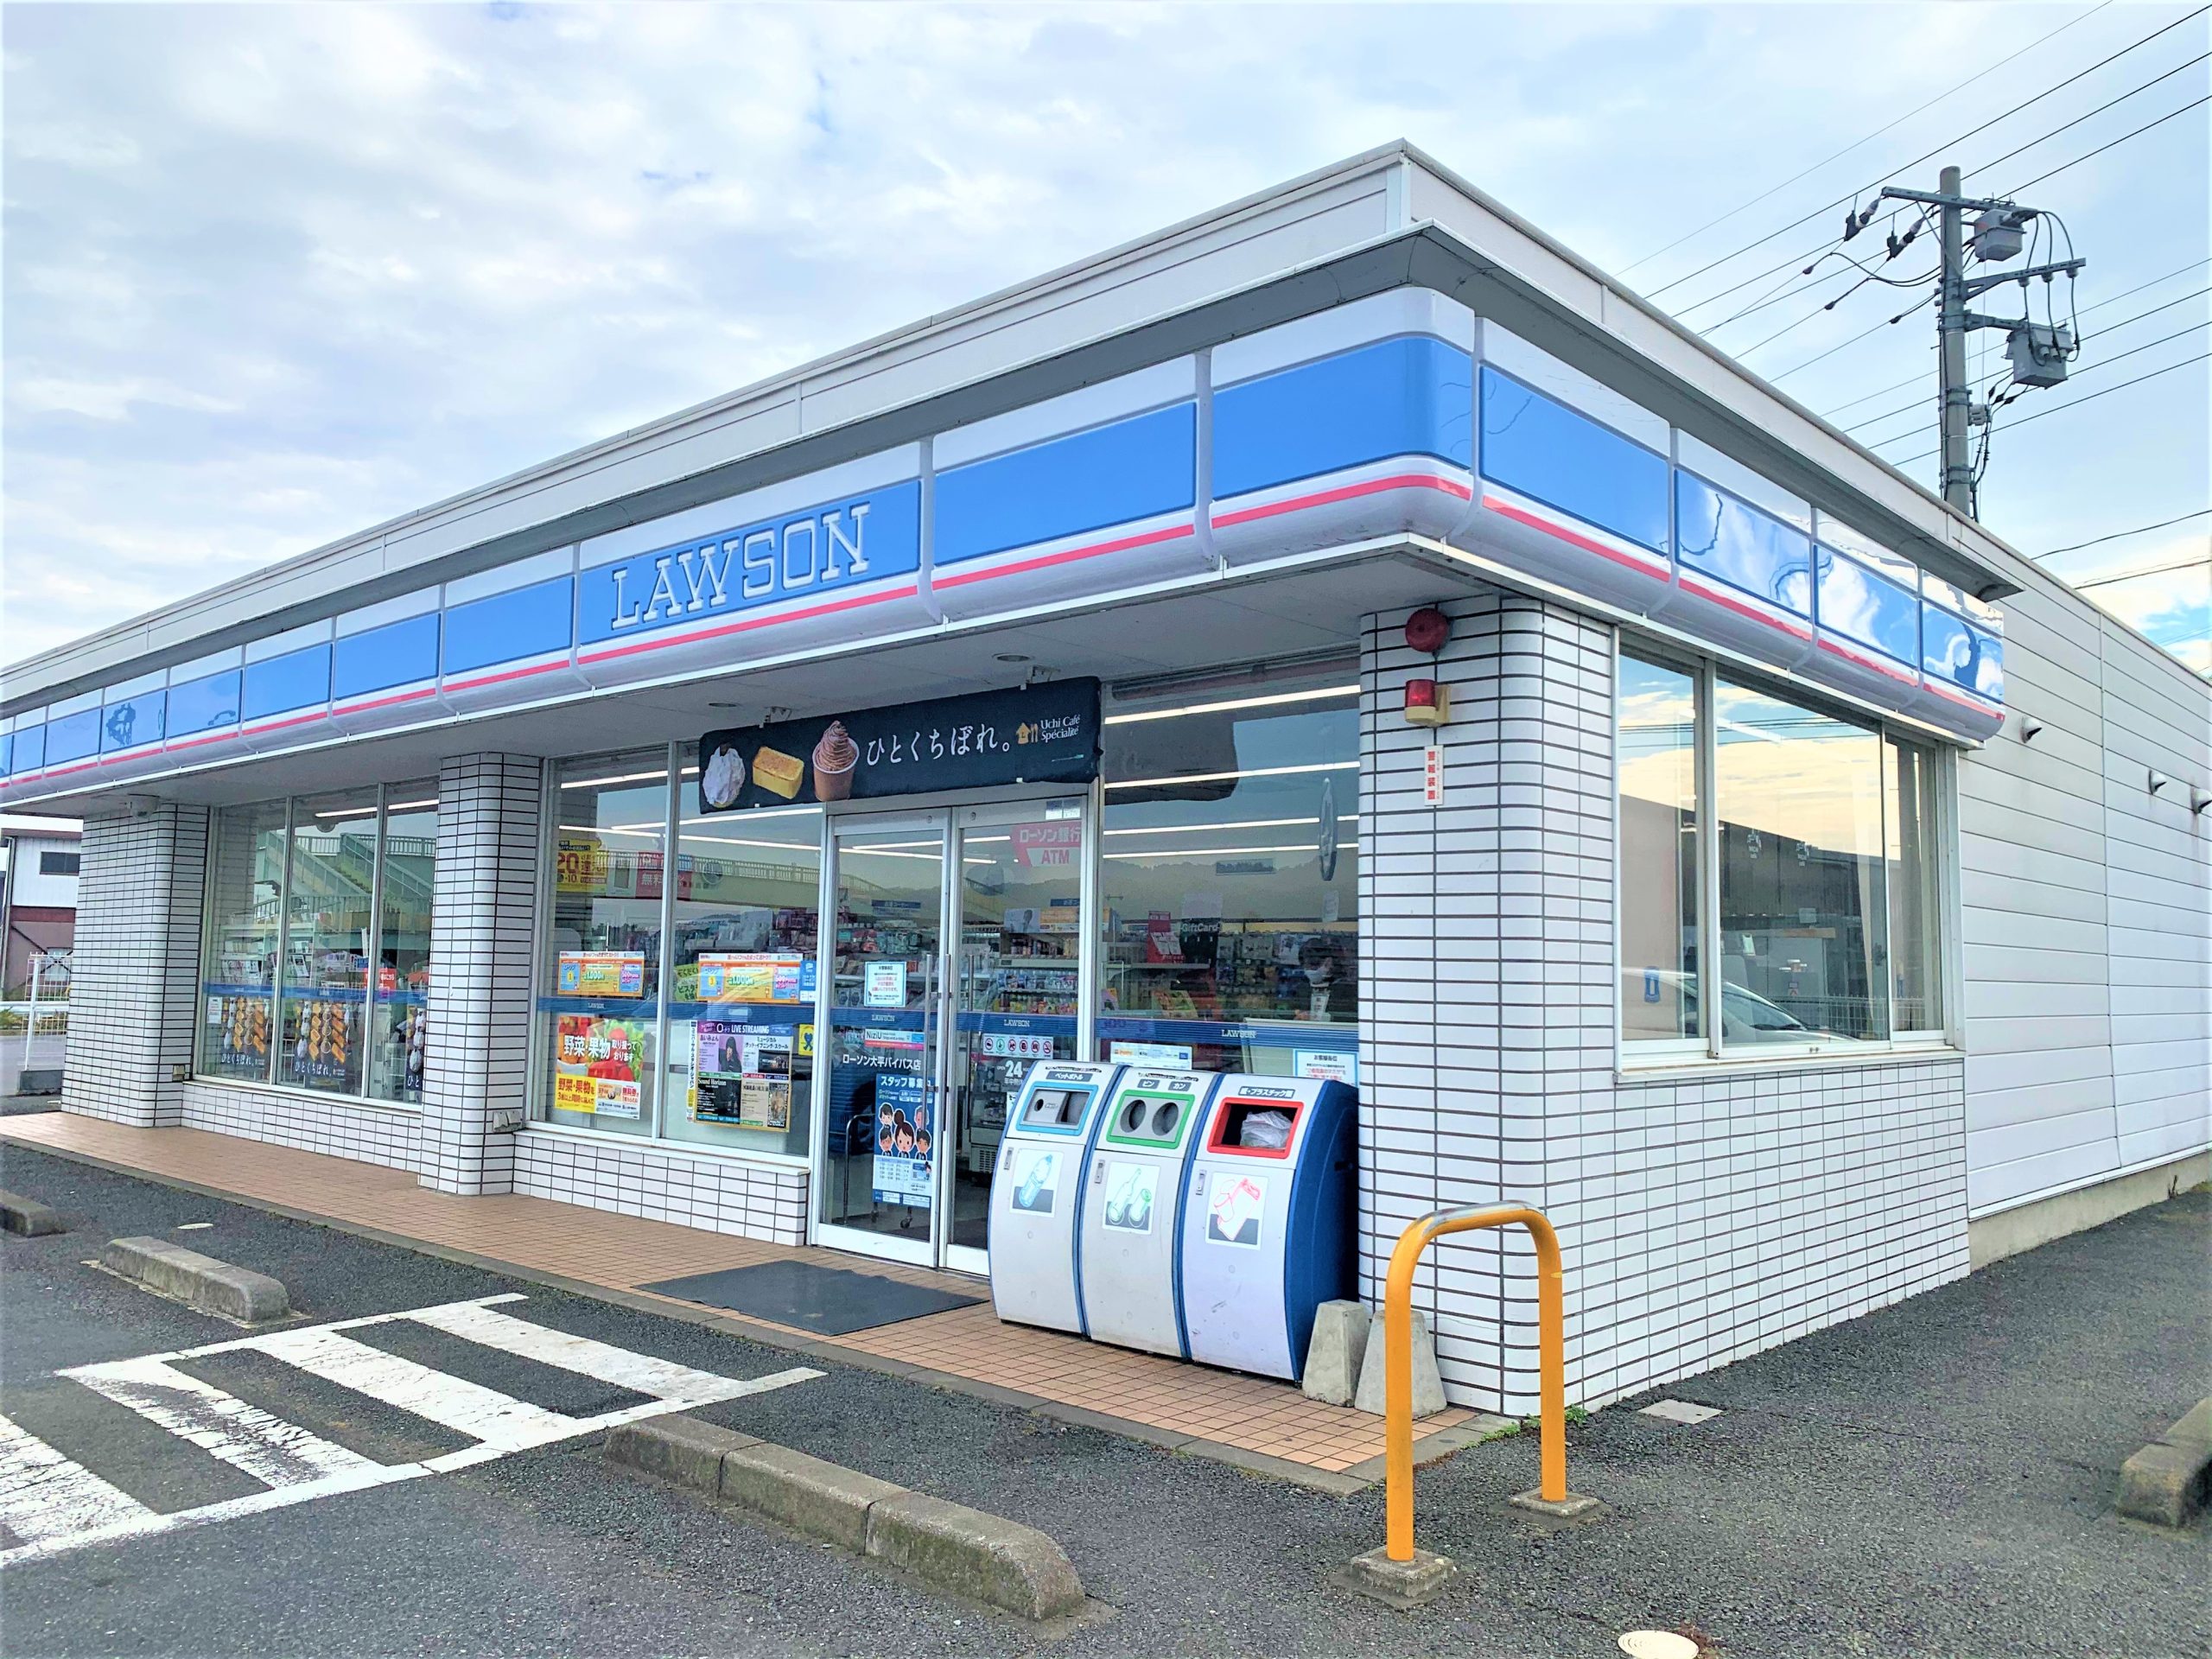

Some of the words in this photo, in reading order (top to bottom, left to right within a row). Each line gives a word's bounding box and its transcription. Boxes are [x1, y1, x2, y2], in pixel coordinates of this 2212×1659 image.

[611, 501, 870, 630] LAWSON
[1040, 718, 1061, 729] Uchi
[1063, 714, 1081, 727] Café
[1040, 726, 1079, 743] Spécialité
[867, 723, 1010, 766] ひとくちぼれ。
[1020, 826, 1081, 843] ローソン銀行
[1041, 849, 1070, 864] ATM
[1003, 1019, 1030, 1027] LAWSON
[866, 1028, 882, 1039] NiziU
[1221, 1029, 1257, 1039] LAWSON
[563, 1035, 611, 1059] 野菜・果物
[842, 1053, 922, 1071] ローソン大平バイパス店
[1005, 1059, 1023, 1078] 24
